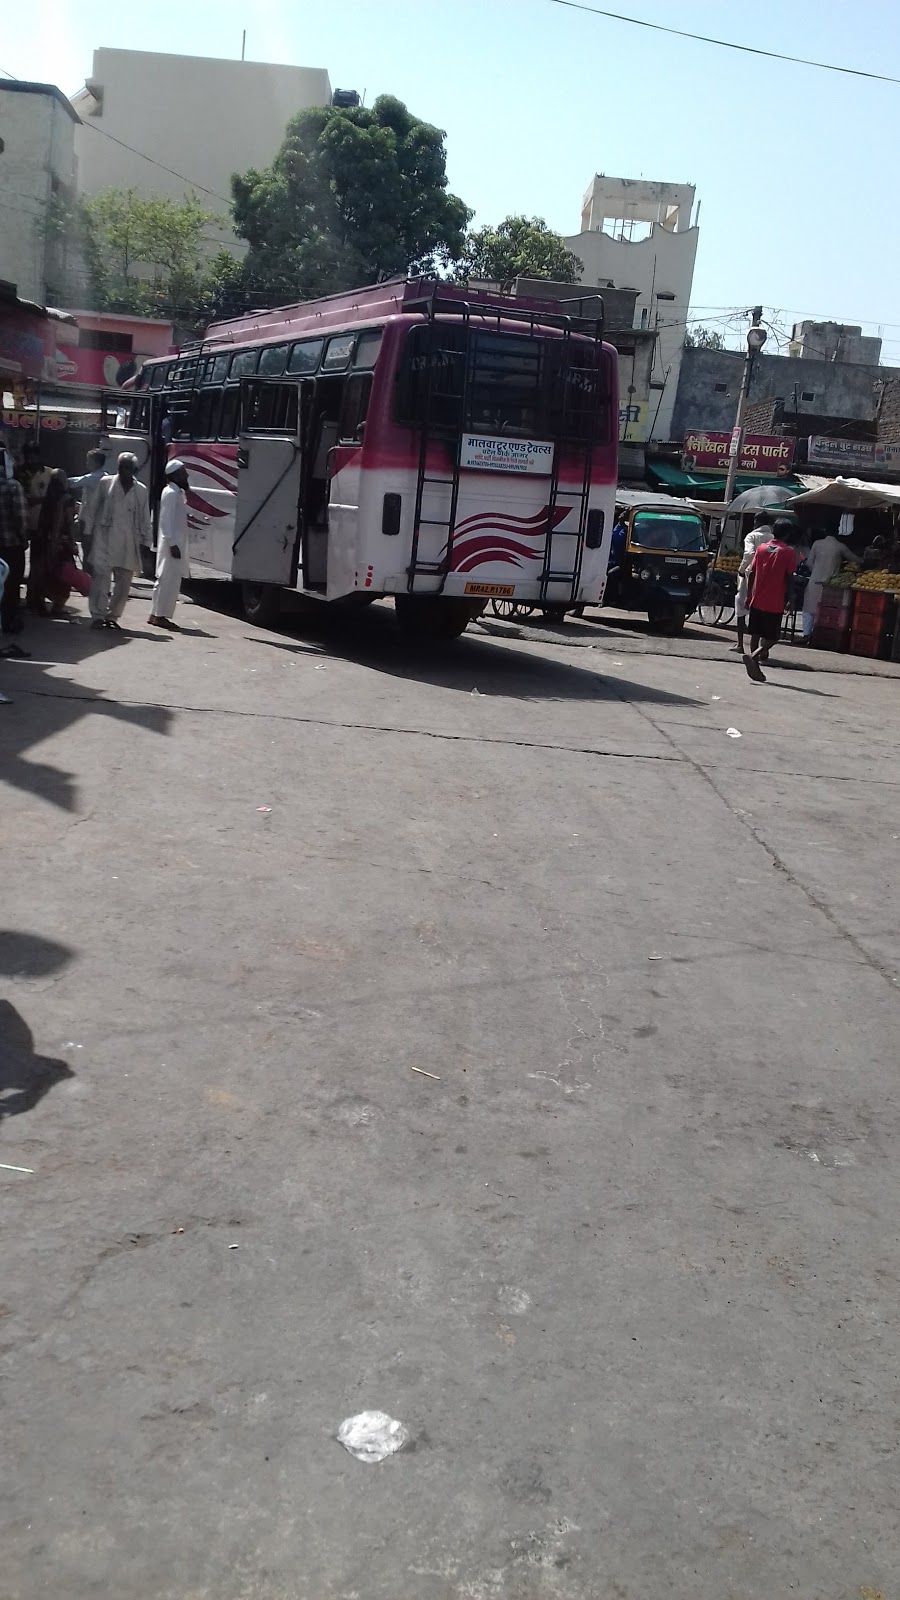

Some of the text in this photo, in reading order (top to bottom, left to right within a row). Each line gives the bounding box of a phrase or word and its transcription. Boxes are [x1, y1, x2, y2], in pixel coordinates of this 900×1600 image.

[2, 410, 67, 431] पलक
[467, 438, 496, 449] मालवा
[497, 441, 508, 451] टूर
[508, 442, 526, 452] एण्ड
[687, 436, 727, 454] निखिल
[762, 442, 790, 458] पार्लर
[741, 458, 758, 469] ग्लो
